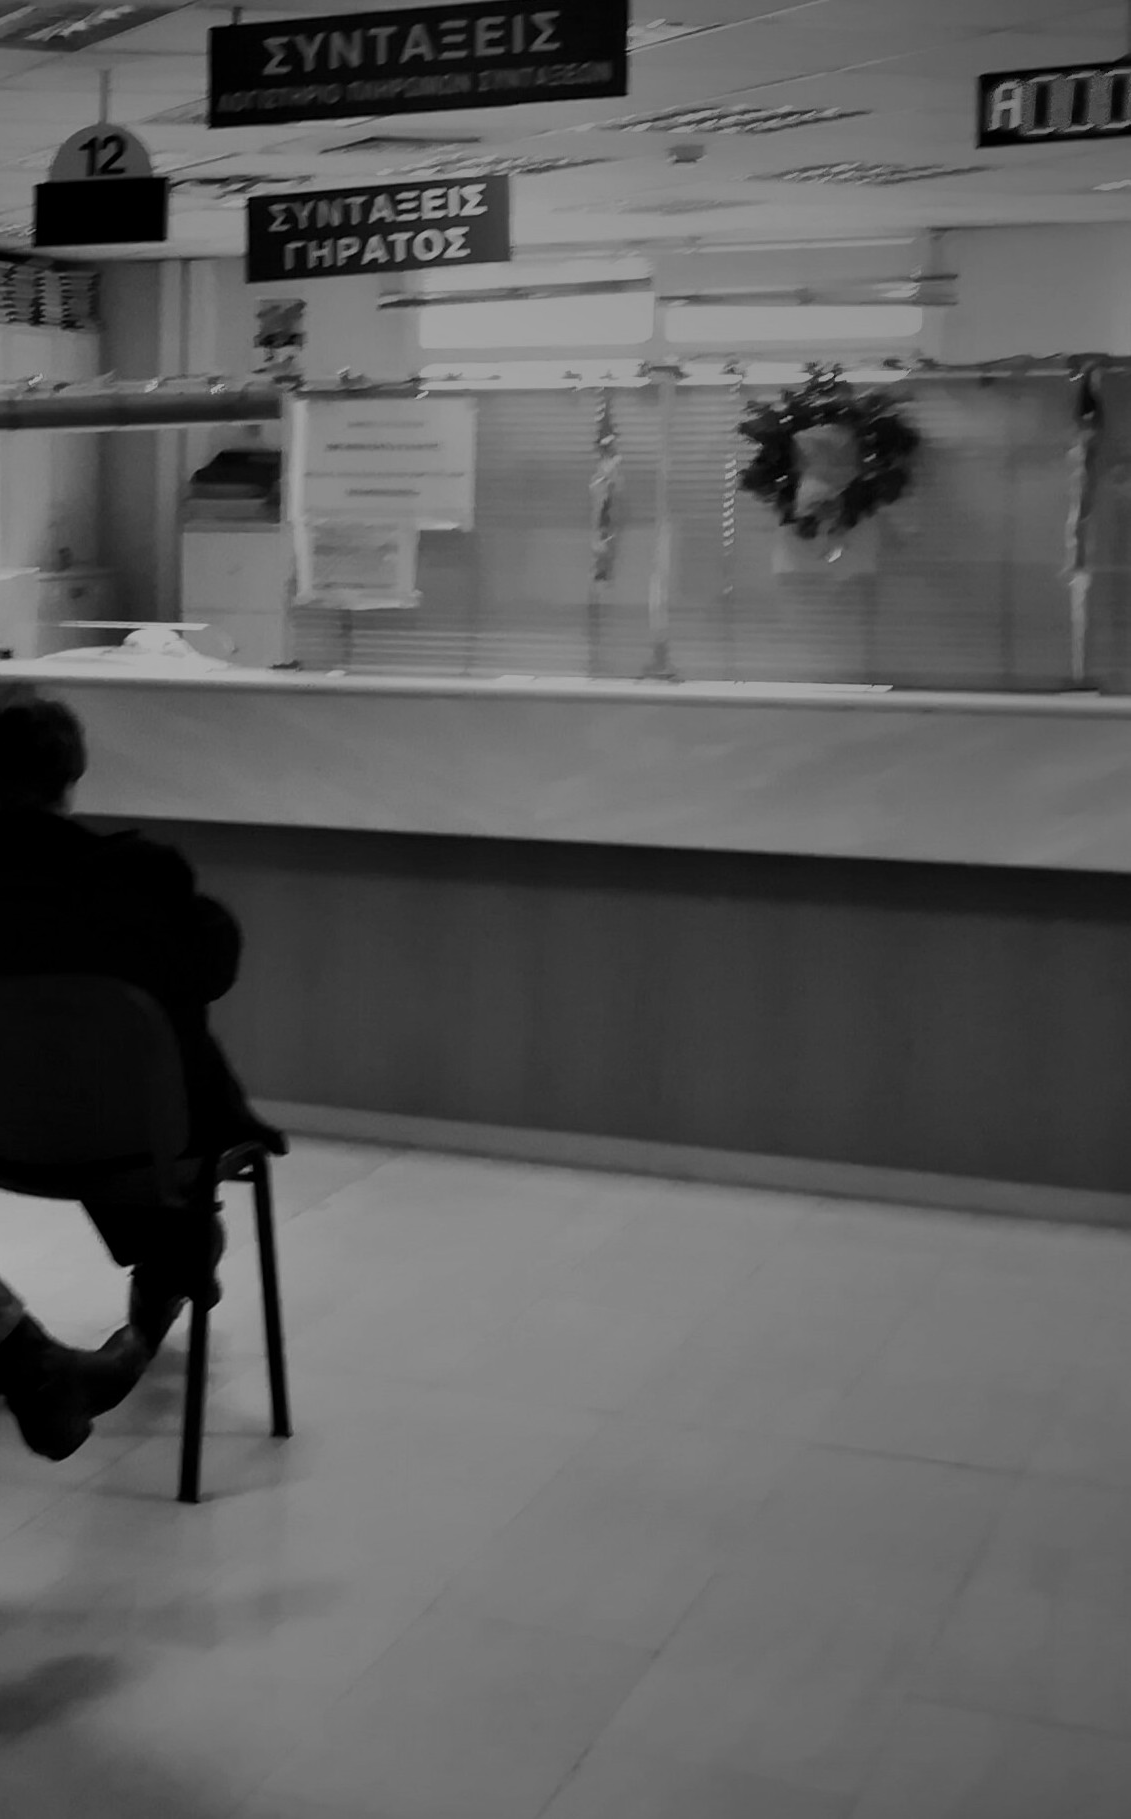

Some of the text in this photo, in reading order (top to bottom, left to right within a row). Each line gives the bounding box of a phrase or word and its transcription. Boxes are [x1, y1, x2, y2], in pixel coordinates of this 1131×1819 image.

[262, 10, 562, 76] ΣΥΝΤΑΞΕΙΣ
[77, 134, 127, 177] 12
[267, 183, 489, 233] ΣΥΝΤΑΞΕΙΣ
[283, 226, 473, 273] ΓΗΡΑΤΟΣ
